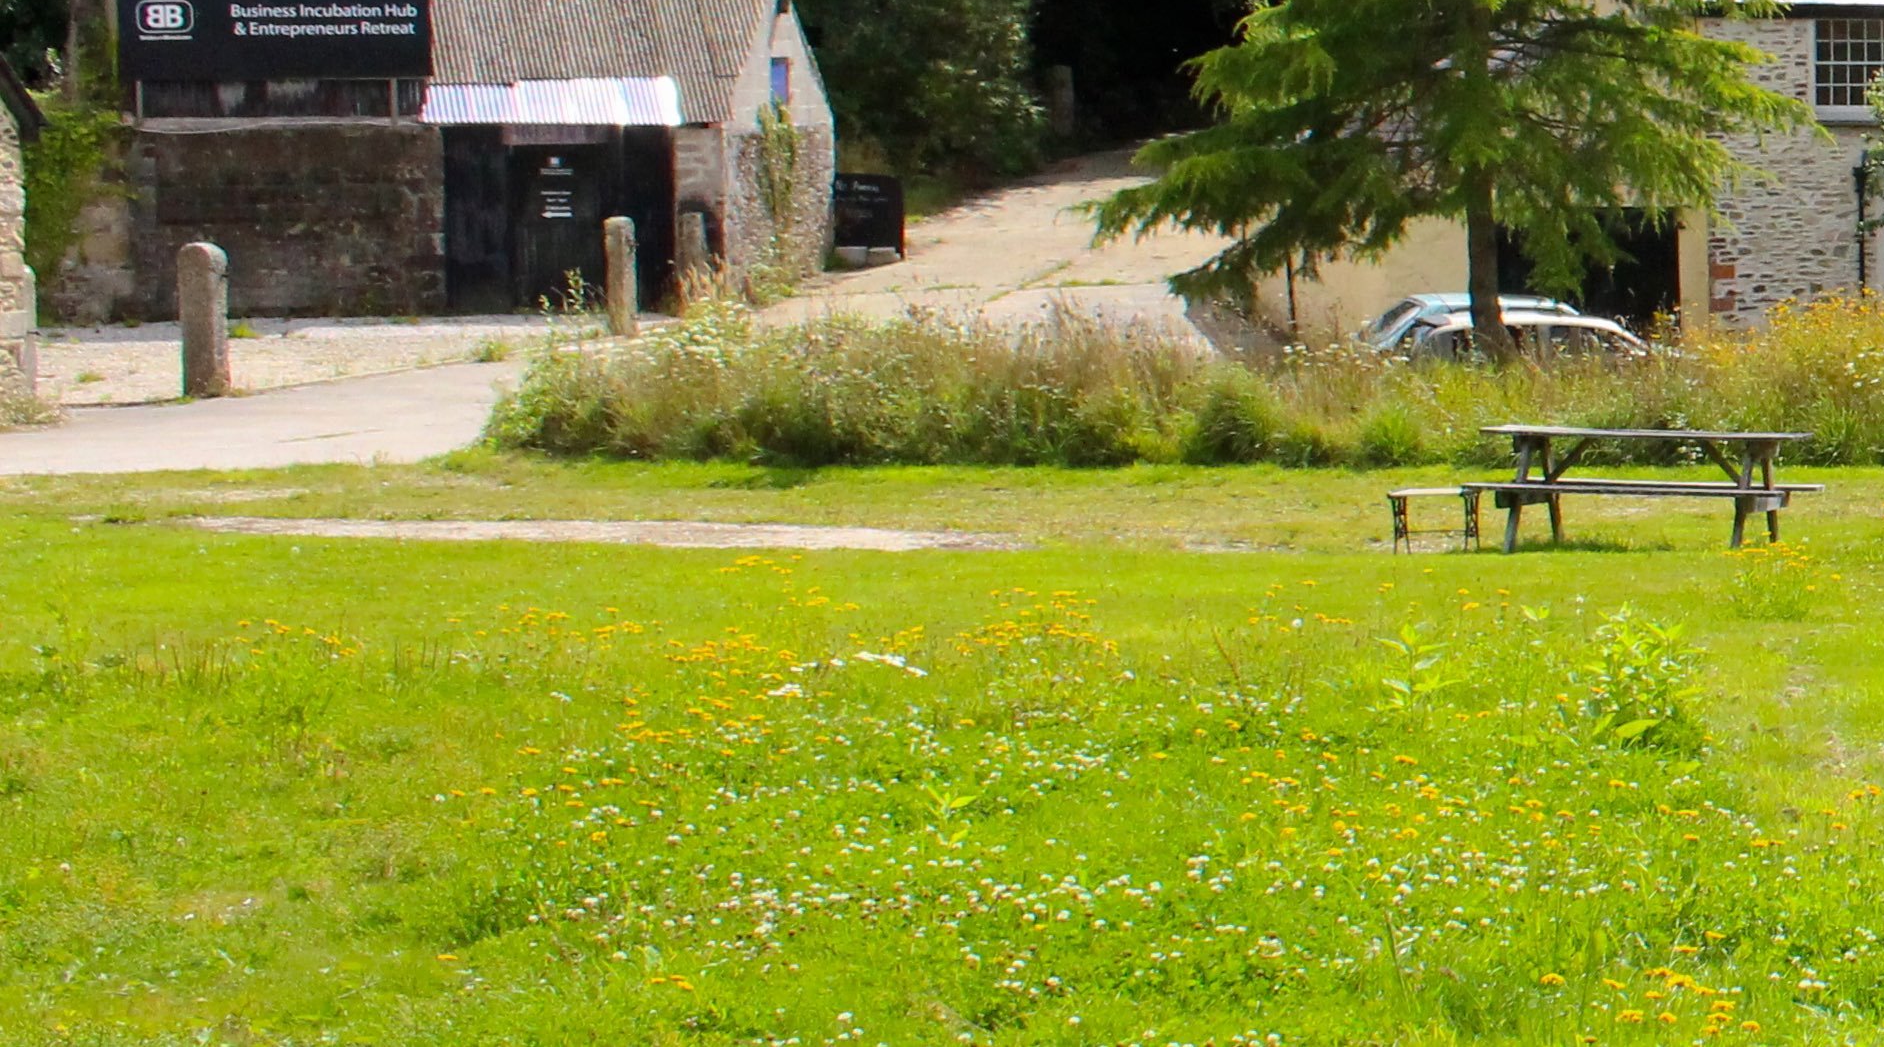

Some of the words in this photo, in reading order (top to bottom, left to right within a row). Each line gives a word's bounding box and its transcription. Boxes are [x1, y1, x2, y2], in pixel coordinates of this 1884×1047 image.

[230, 4, 297, 18] Business
[300, 4, 382, 18] Incubation
[385, 4, 418, 18] Hub
[234, 22, 247, 36] &
[250, 22, 358, 38] Entrepreneurs
[360, 21, 415, 35] Retreat
